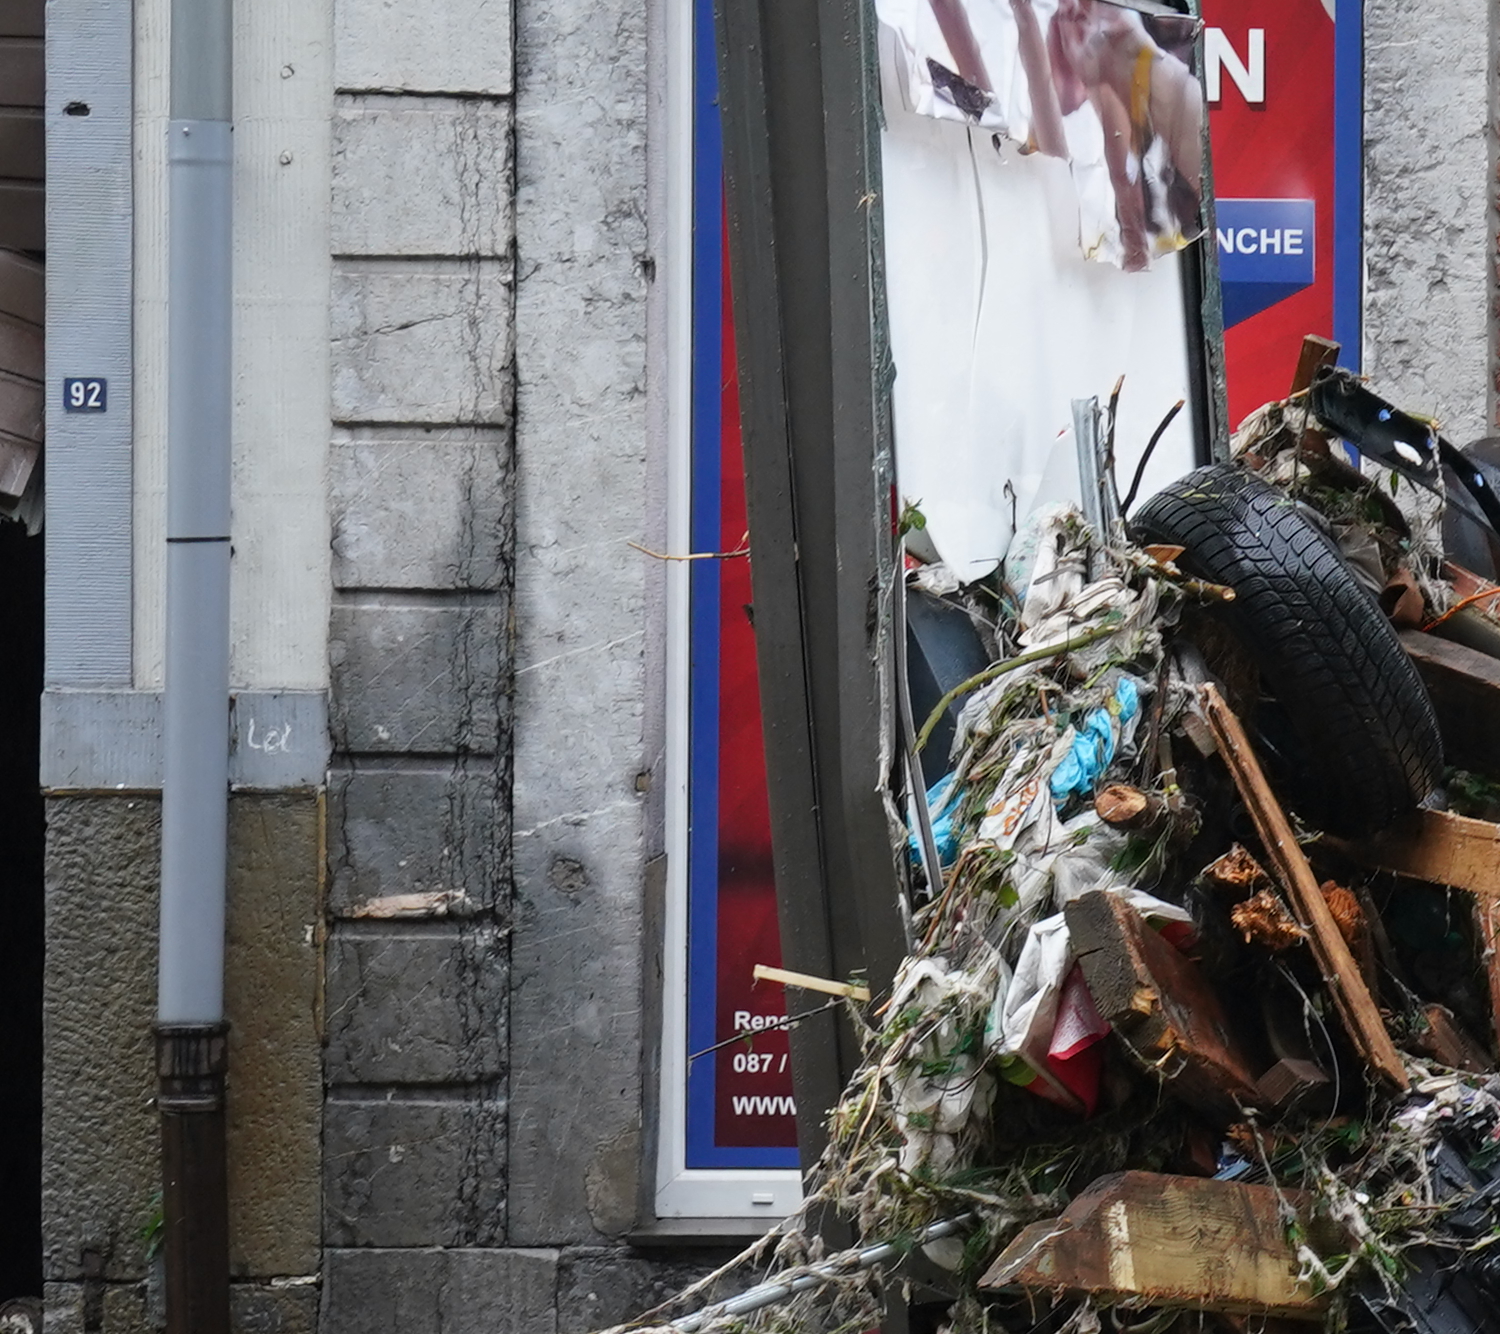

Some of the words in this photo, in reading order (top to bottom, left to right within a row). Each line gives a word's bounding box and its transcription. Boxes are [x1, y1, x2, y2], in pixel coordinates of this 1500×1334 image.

[1216, 227, 1304, 255] NCHE
[70, 381, 101, 407] 92
[733, 1053, 774, 1073] 087
